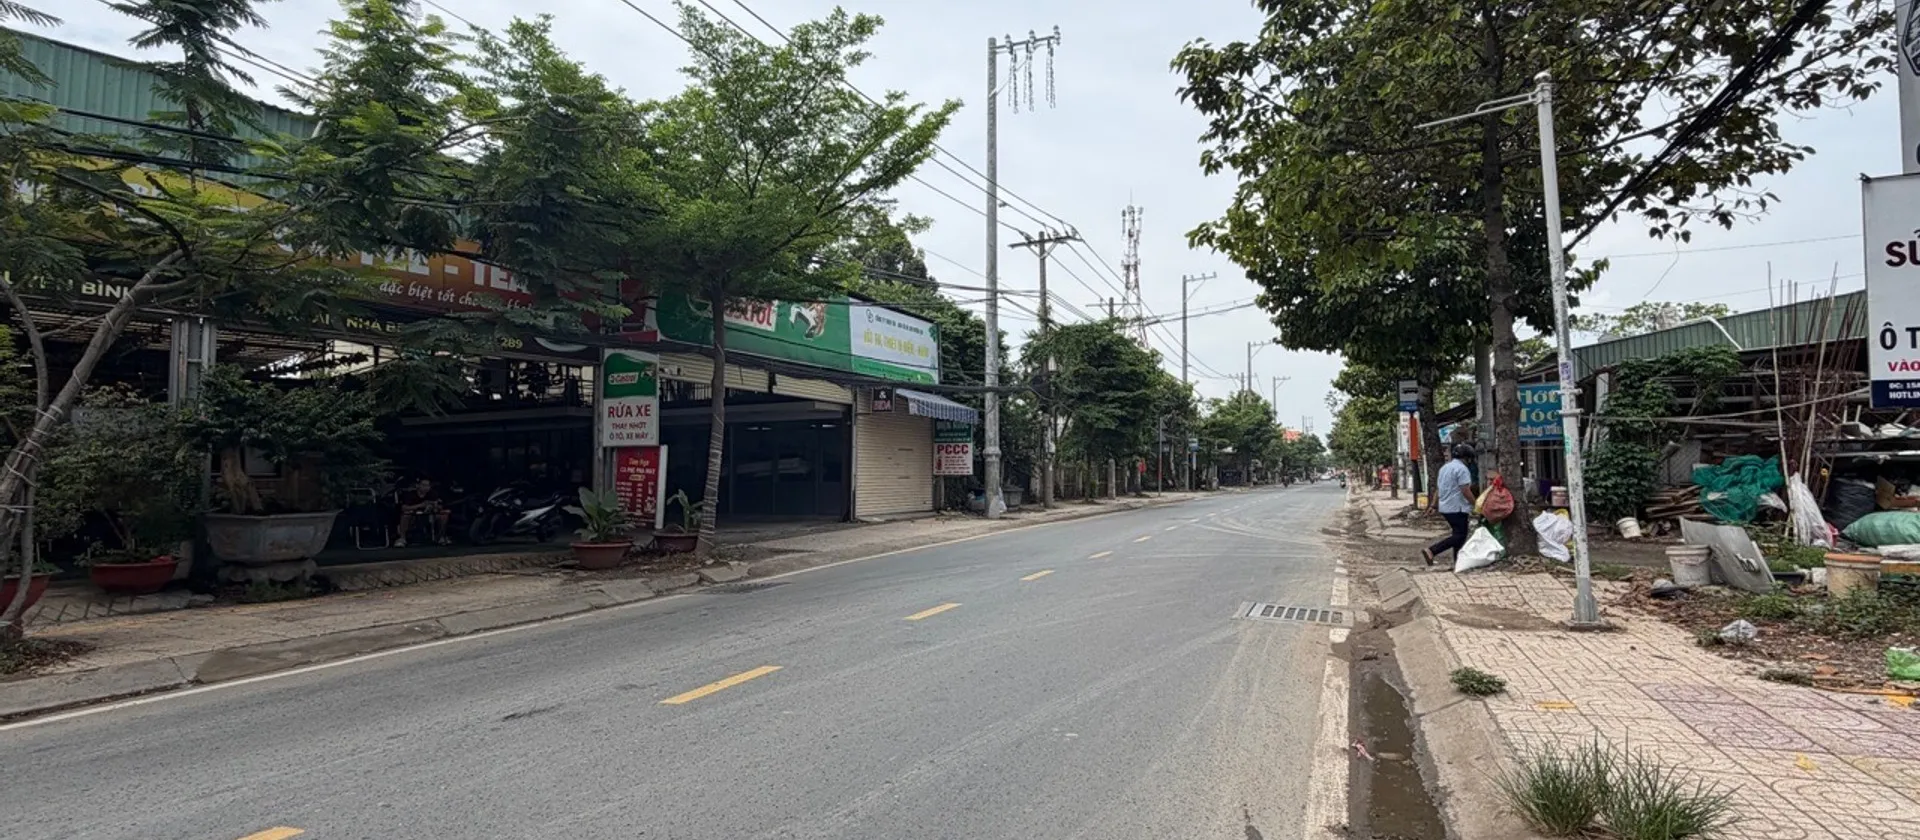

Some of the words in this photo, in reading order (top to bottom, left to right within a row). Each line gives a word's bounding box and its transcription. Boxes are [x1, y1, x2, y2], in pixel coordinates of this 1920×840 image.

[407, 281, 432, 302] biệt
[437, 287, 455, 303] tốt
[500, 337, 523, 350] 289
[1879, 321, 1897, 351] Ô
[608, 401, 633, 419] RỬA
[635, 404, 651, 417] XE
[937, 444, 969, 455] PCCC
